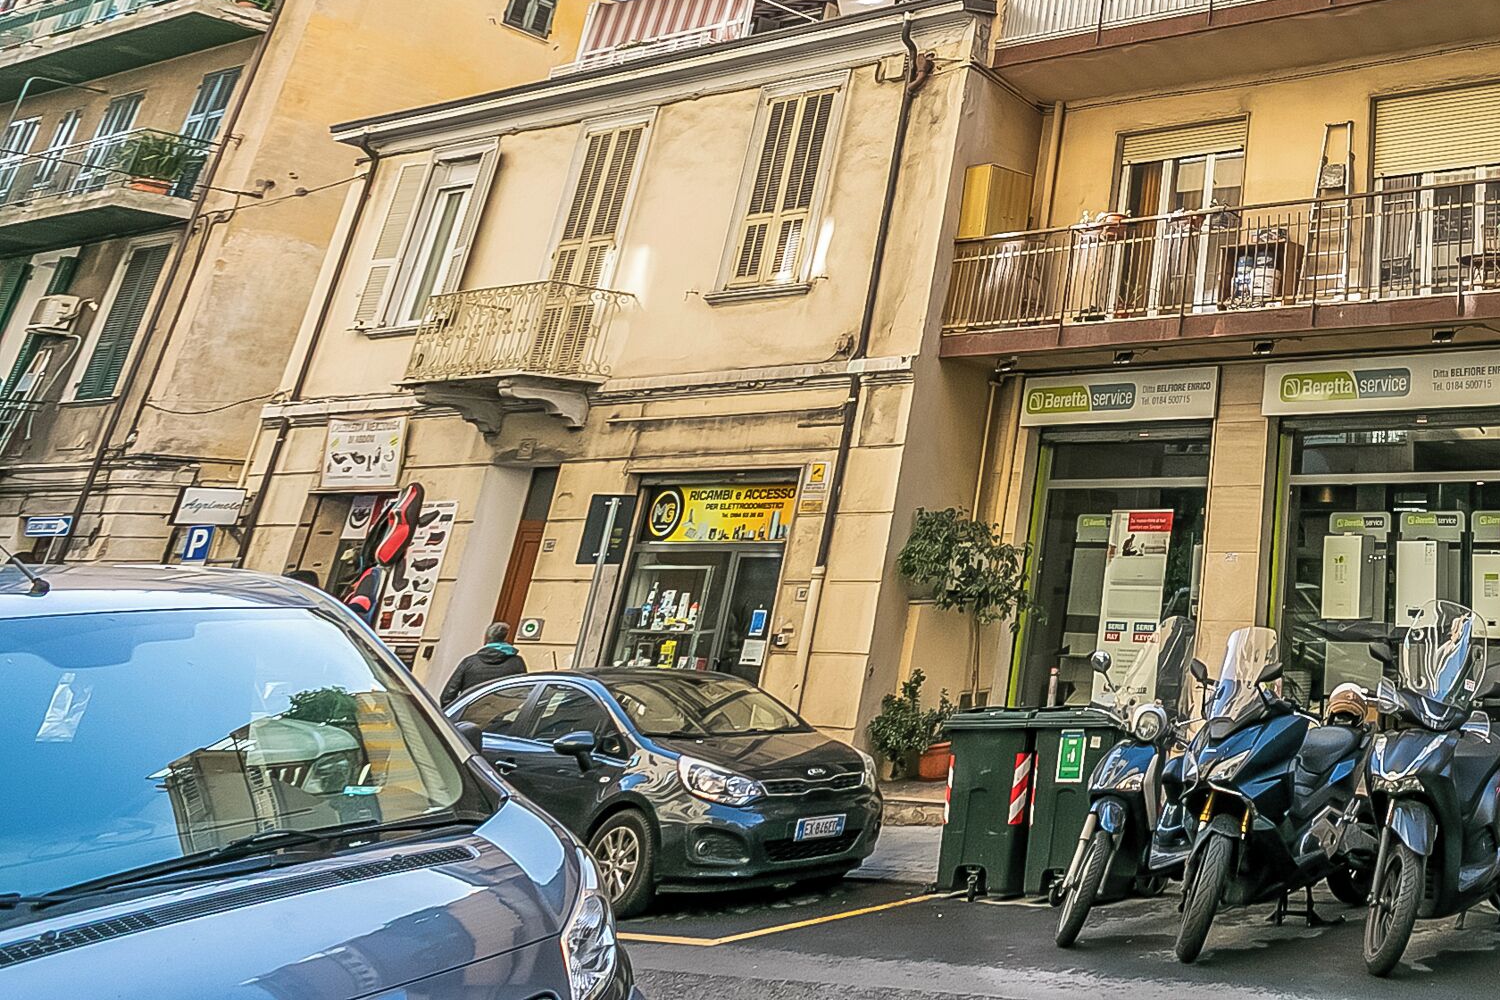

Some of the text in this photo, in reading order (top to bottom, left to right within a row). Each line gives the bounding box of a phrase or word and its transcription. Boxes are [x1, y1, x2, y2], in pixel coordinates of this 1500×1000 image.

[1433, 369, 1449, 379] Ditta
[1450, 367, 1486, 378] BELFIORE
[1142, 381, 1211, 394] Ditta BELFIORE ENRICO
[1302, 375, 1407, 395] Beretta service
[1432, 380, 1492, 392] Tel. 0184 500715
[1044, 389, 1133, 408] Beretta service
[1151, 397, 1167, 405] 0184
[1167, 395, 1190, 404] 500715
[689, 490, 734, 501] RICAMBI
[735, 491, 742, 500] e
[719, 502, 785, 510] ELETTRODOMESTICI
[652, 503, 676, 524] MG
[1365, 518, 1384, 528] service
[1438, 516, 1457, 525] service
[186, 529, 209, 557] P
